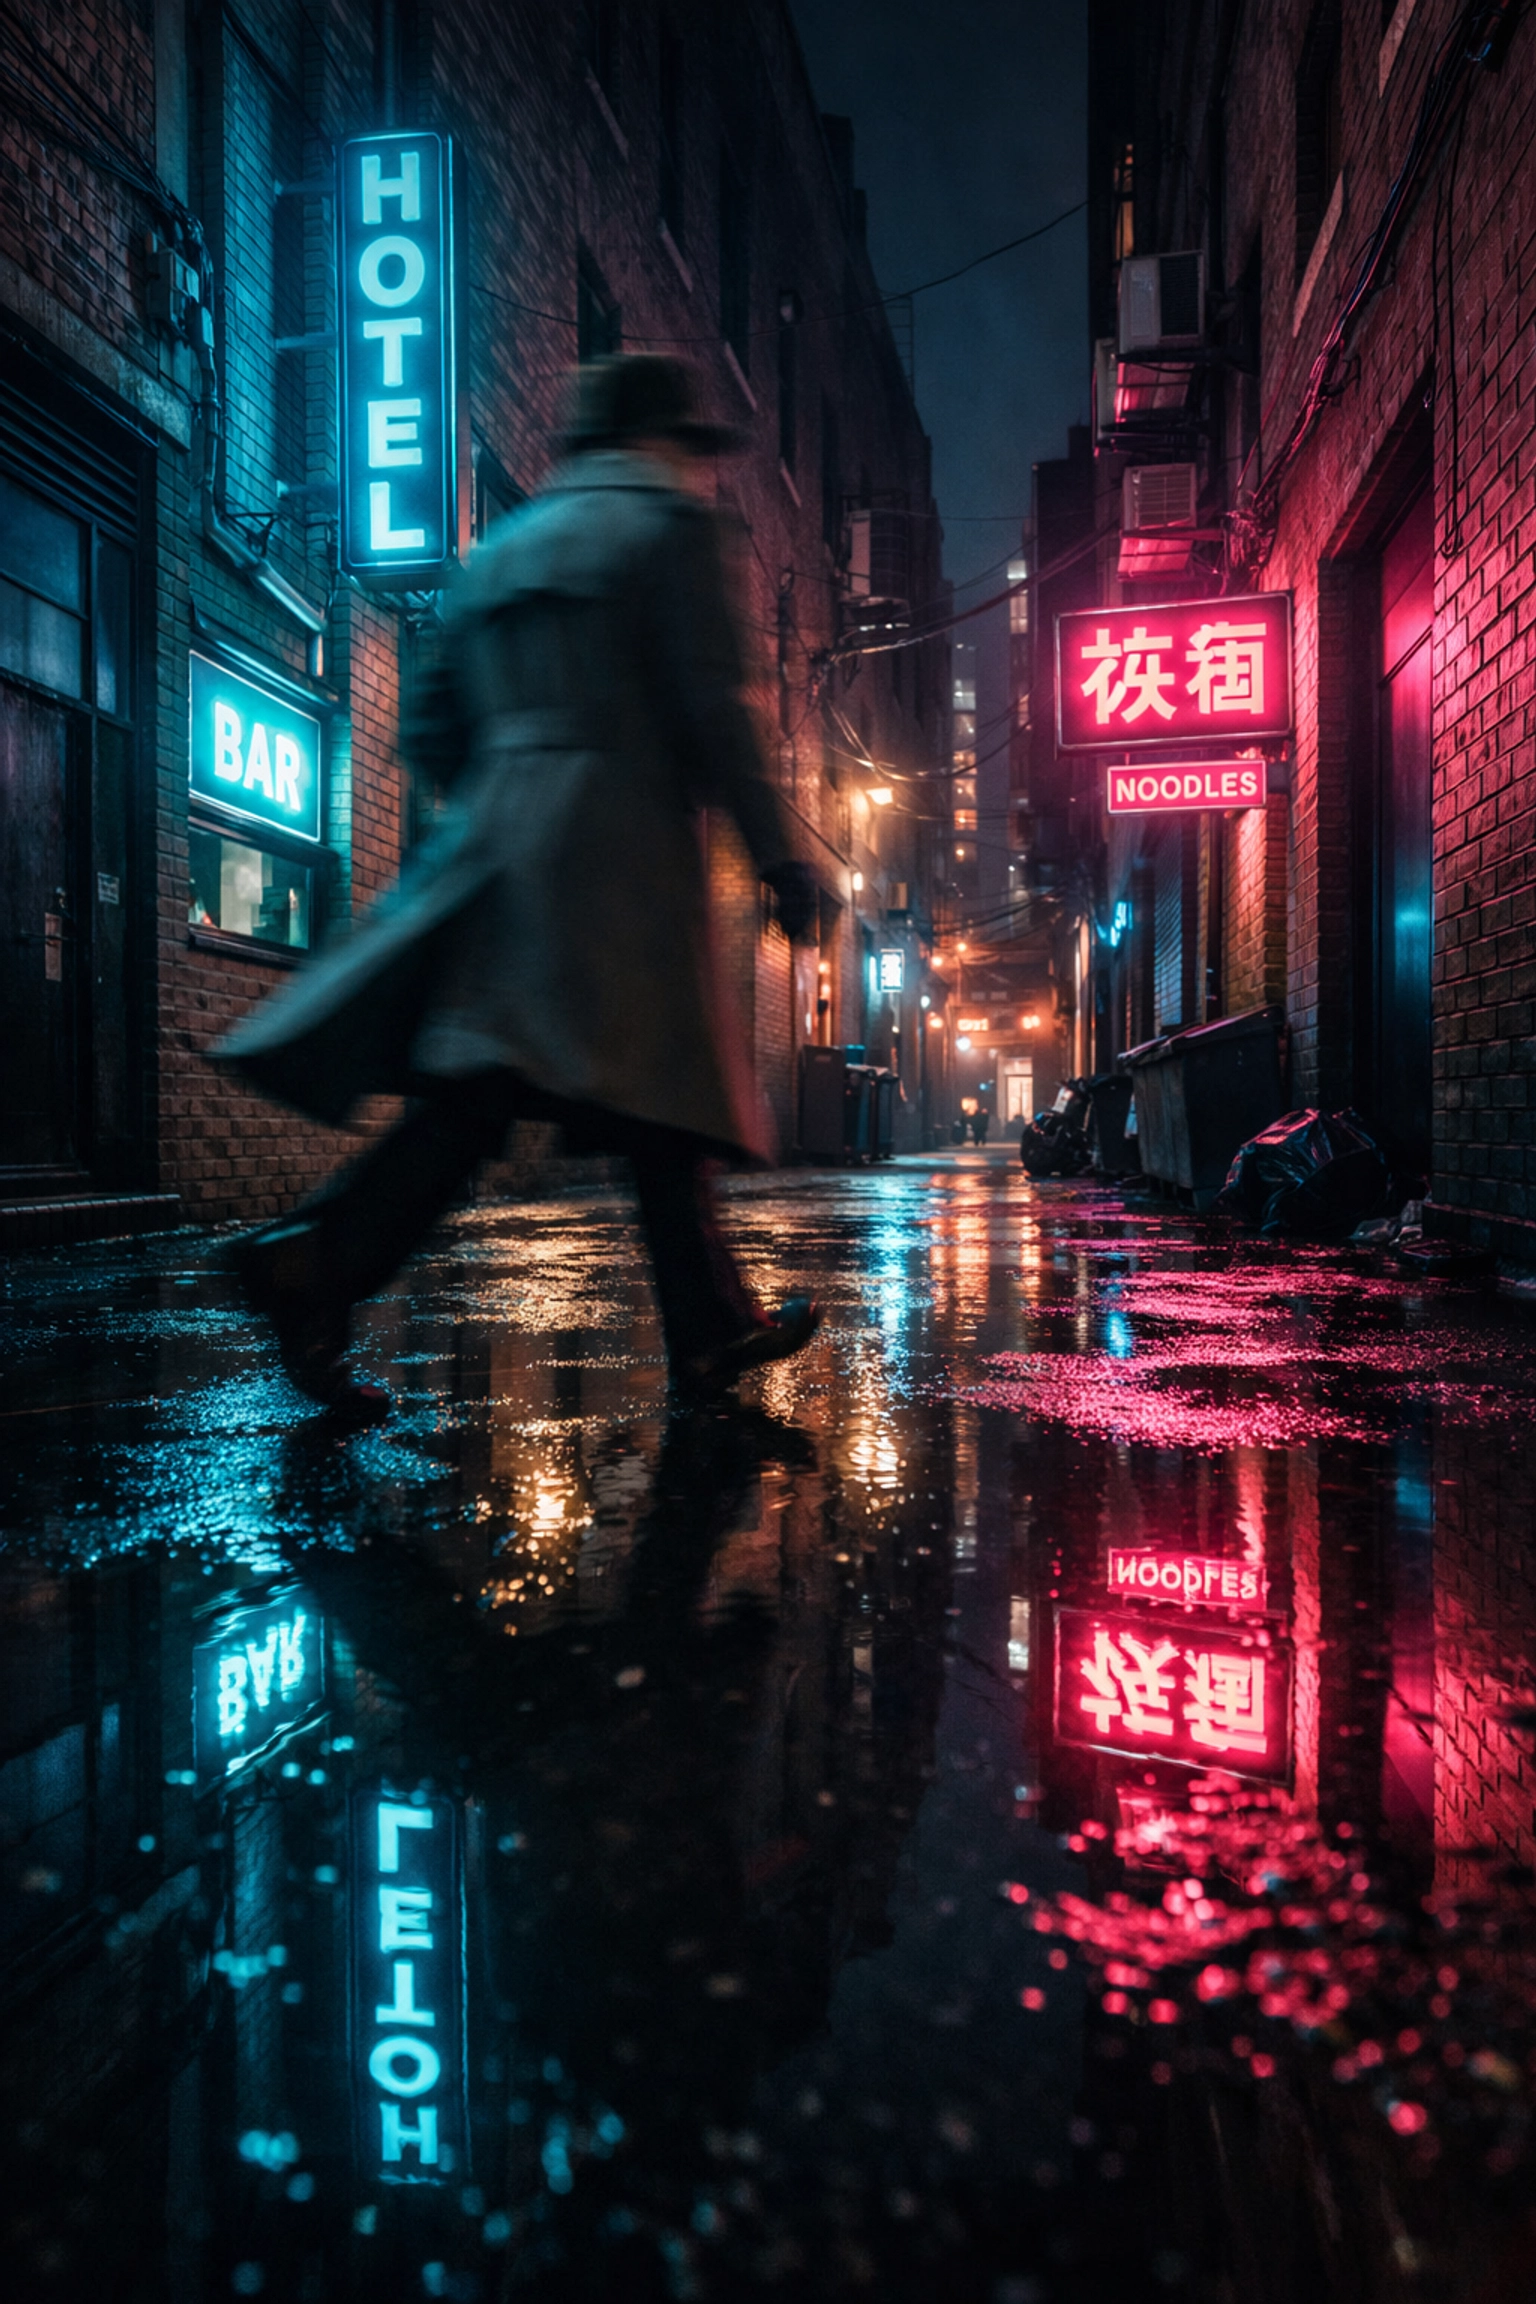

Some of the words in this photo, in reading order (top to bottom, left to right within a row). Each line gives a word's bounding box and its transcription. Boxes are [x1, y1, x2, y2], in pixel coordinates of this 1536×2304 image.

[359, 152, 426, 550] HOTEL
[214, 701, 301, 812] BAR
[1116, 772, 1257, 802] NOODLES
